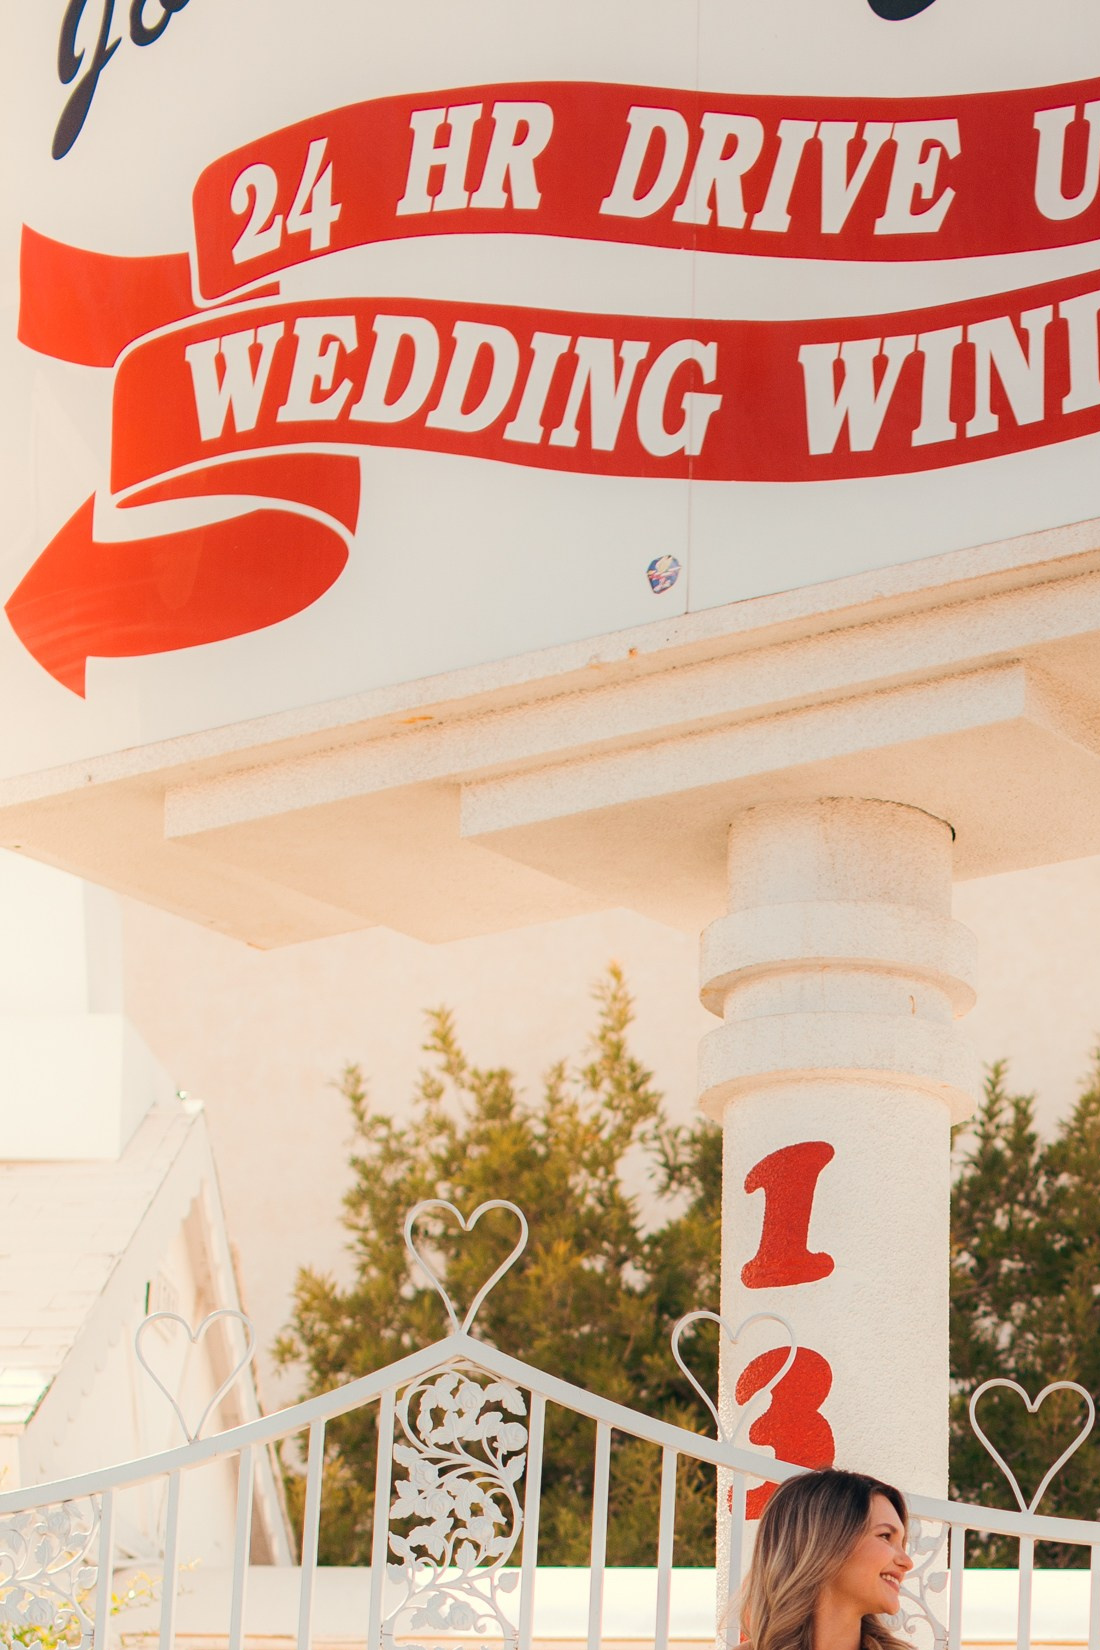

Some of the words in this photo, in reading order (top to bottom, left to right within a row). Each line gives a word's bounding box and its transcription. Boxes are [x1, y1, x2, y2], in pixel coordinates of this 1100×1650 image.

[230, 137, 342, 265] 24
[395, 101, 555, 217] HR
[598, 106, 962, 236] DRIVE
[184, 314, 723, 458] WEDDING
